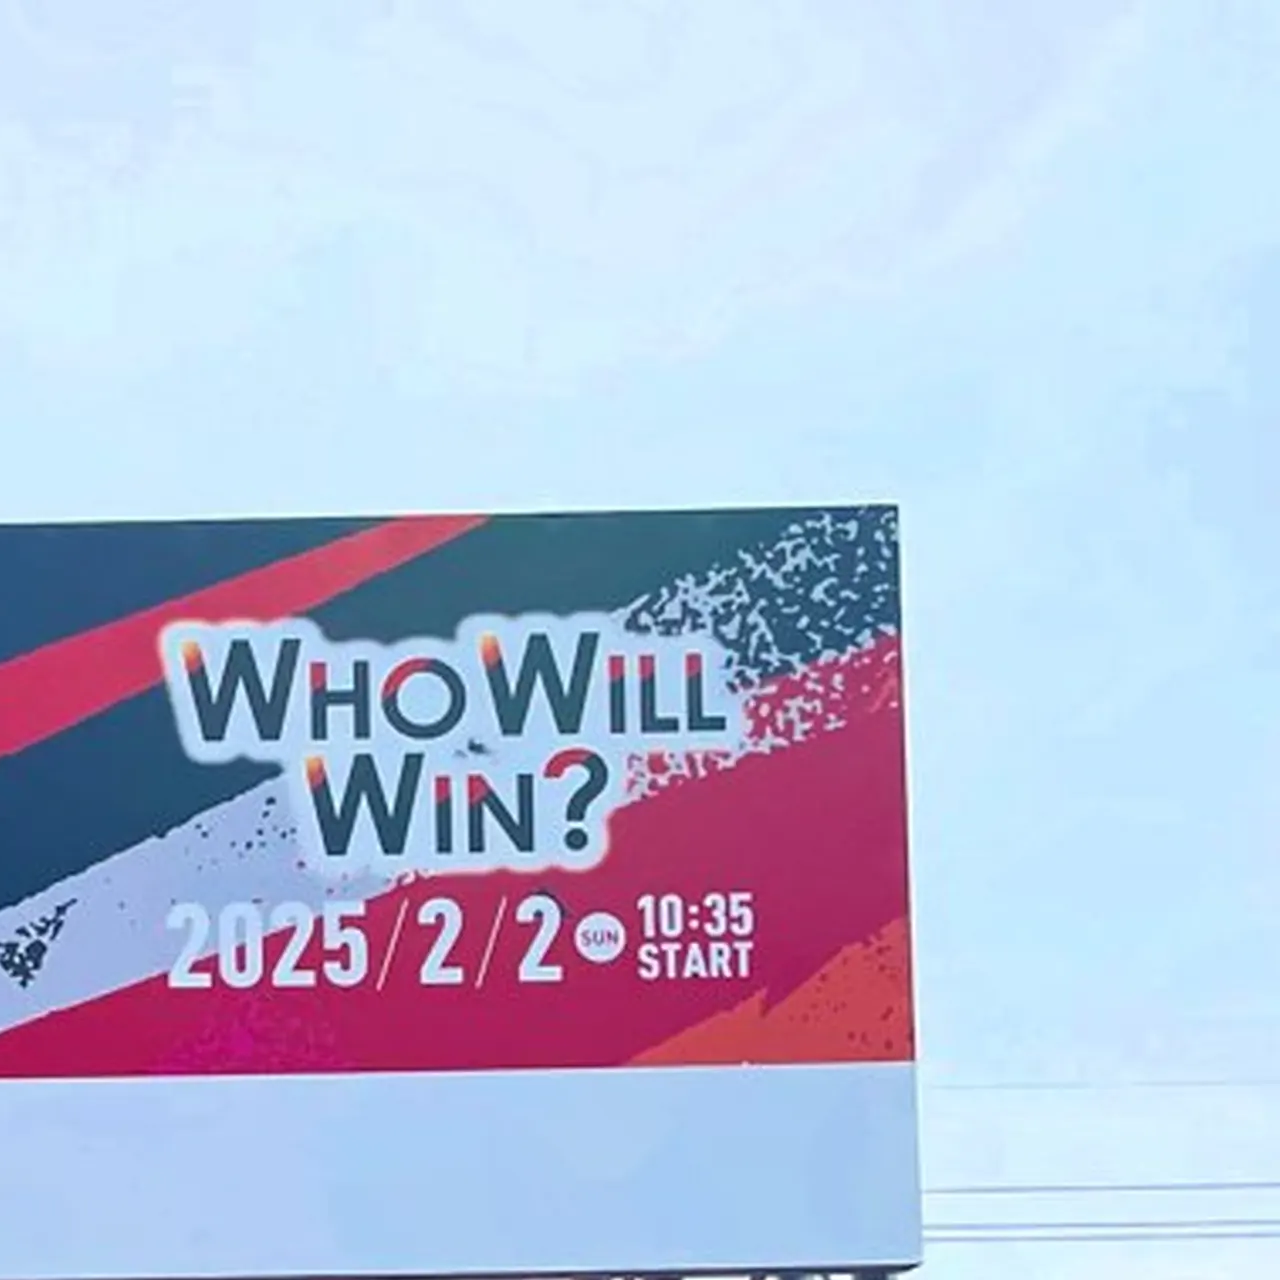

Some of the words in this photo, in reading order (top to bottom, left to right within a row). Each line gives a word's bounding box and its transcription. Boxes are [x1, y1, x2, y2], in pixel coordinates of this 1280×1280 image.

[183, 638, 466, 741] WHO
[481, 632, 727, 736] WILL
[306, 749, 609, 857] WIN?
[636, 892, 755, 938] 10:35
[637, 941, 755, 980] START
